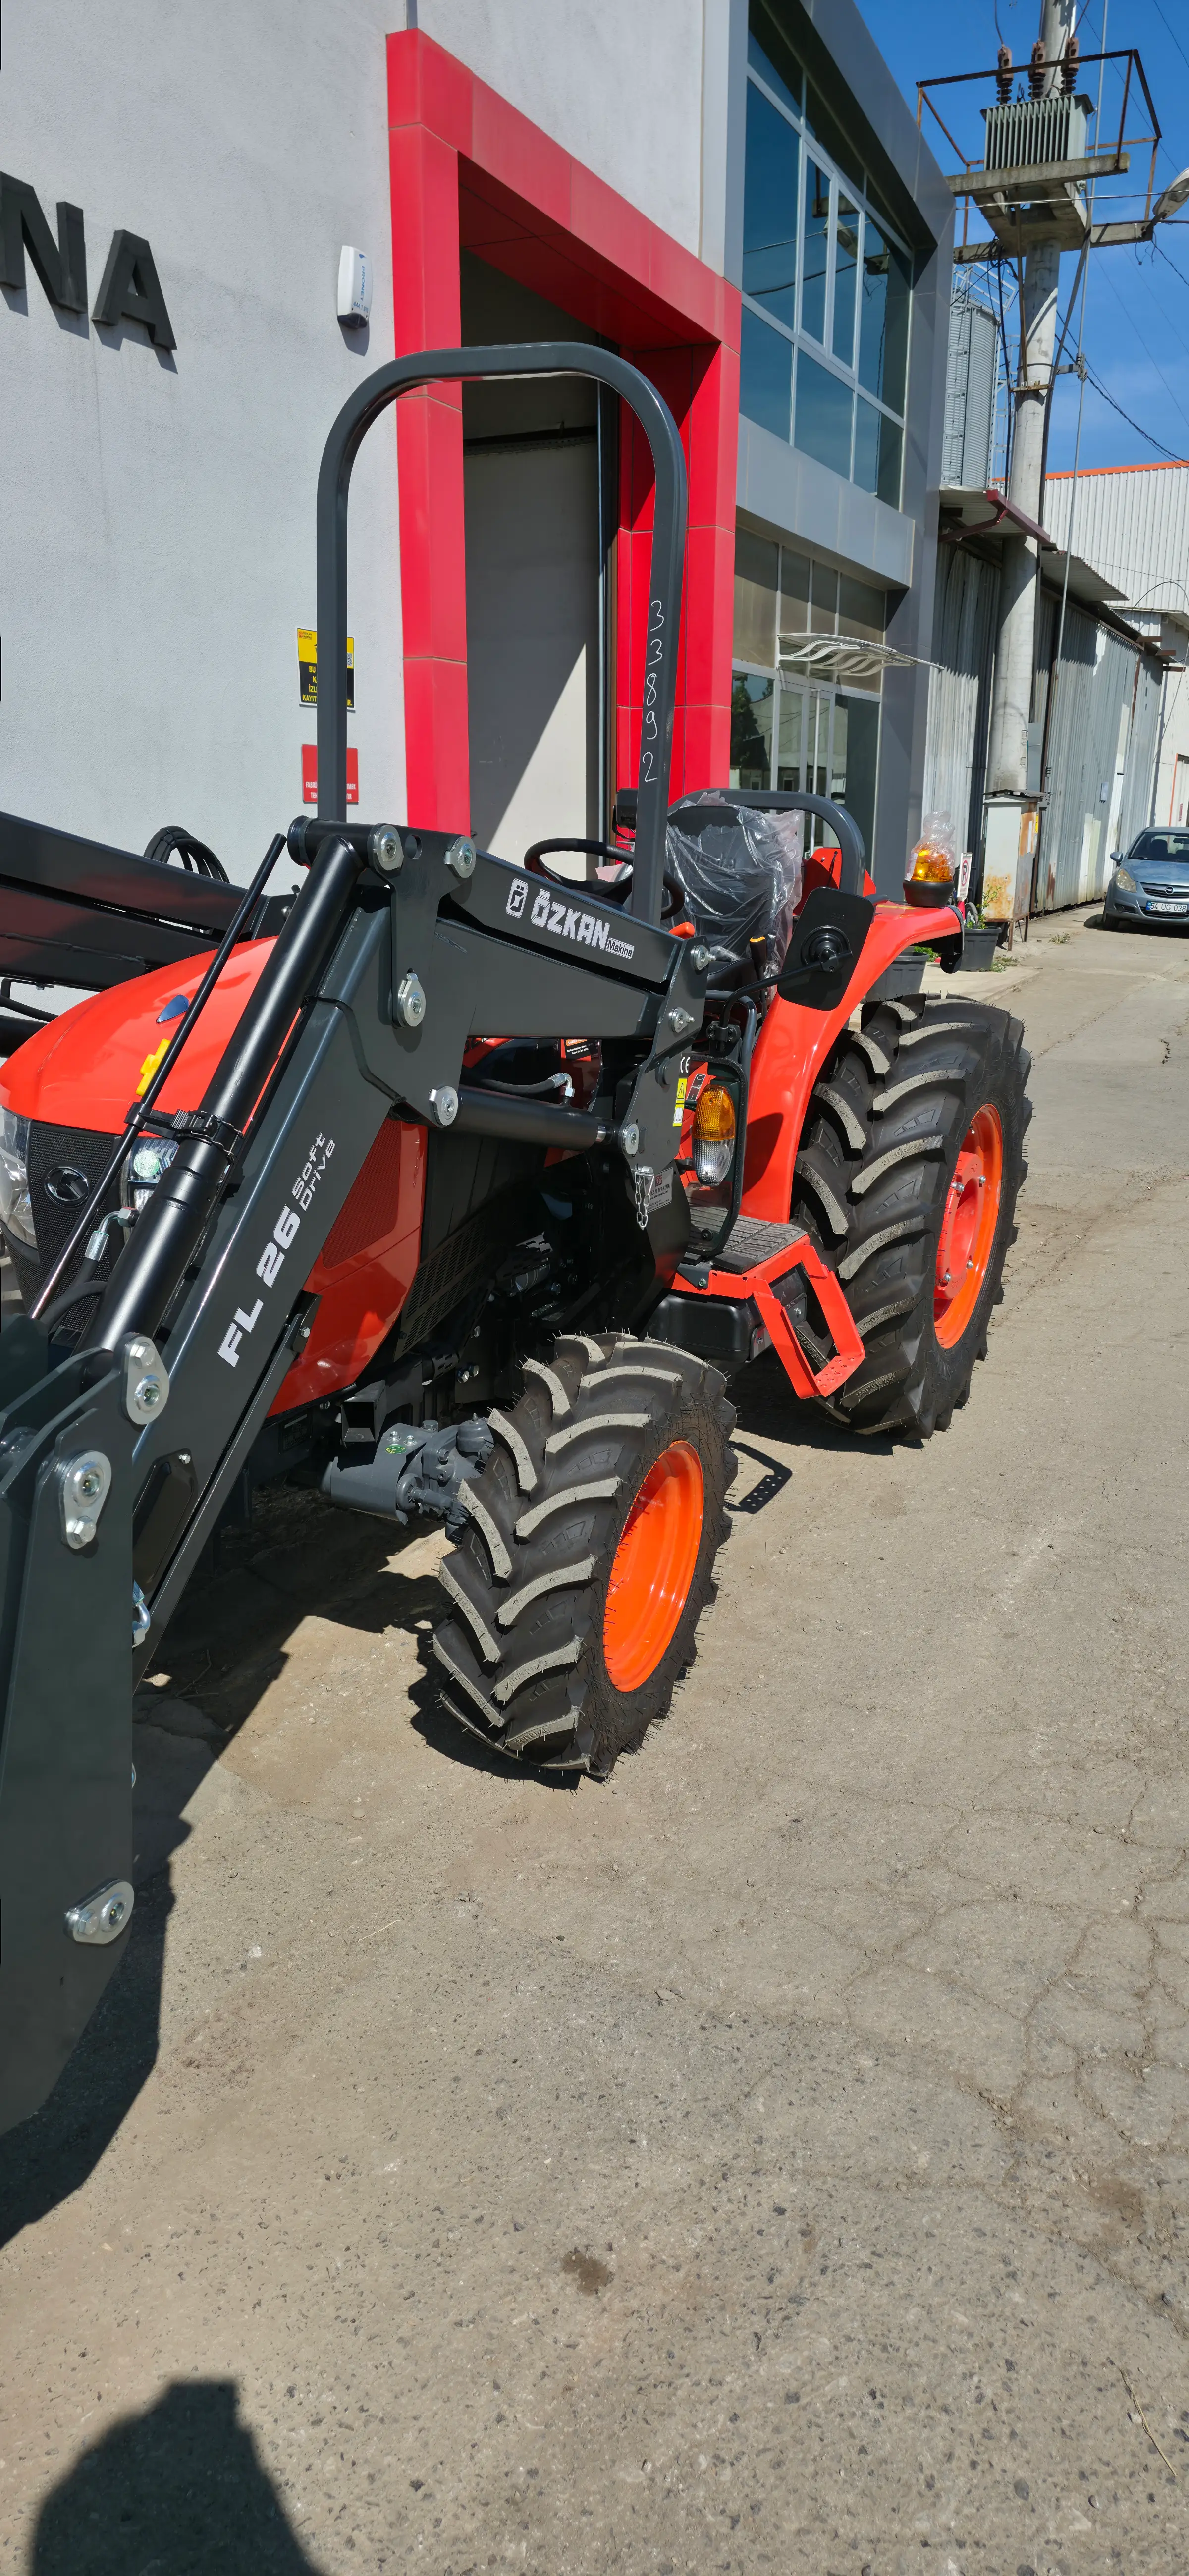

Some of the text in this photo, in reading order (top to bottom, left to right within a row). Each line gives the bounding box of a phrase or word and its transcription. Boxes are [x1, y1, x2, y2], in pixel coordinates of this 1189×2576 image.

[0, 171, 177, 351] NA
[643, 600, 664, 782] 33892
[531, 889, 610, 950] ÖZKAN
[607, 941, 632, 957] Makina
[292, 1131, 326, 1200] Soft
[299, 1138, 335, 1212] Drive
[217, 1204, 301, 1368] FL 26
